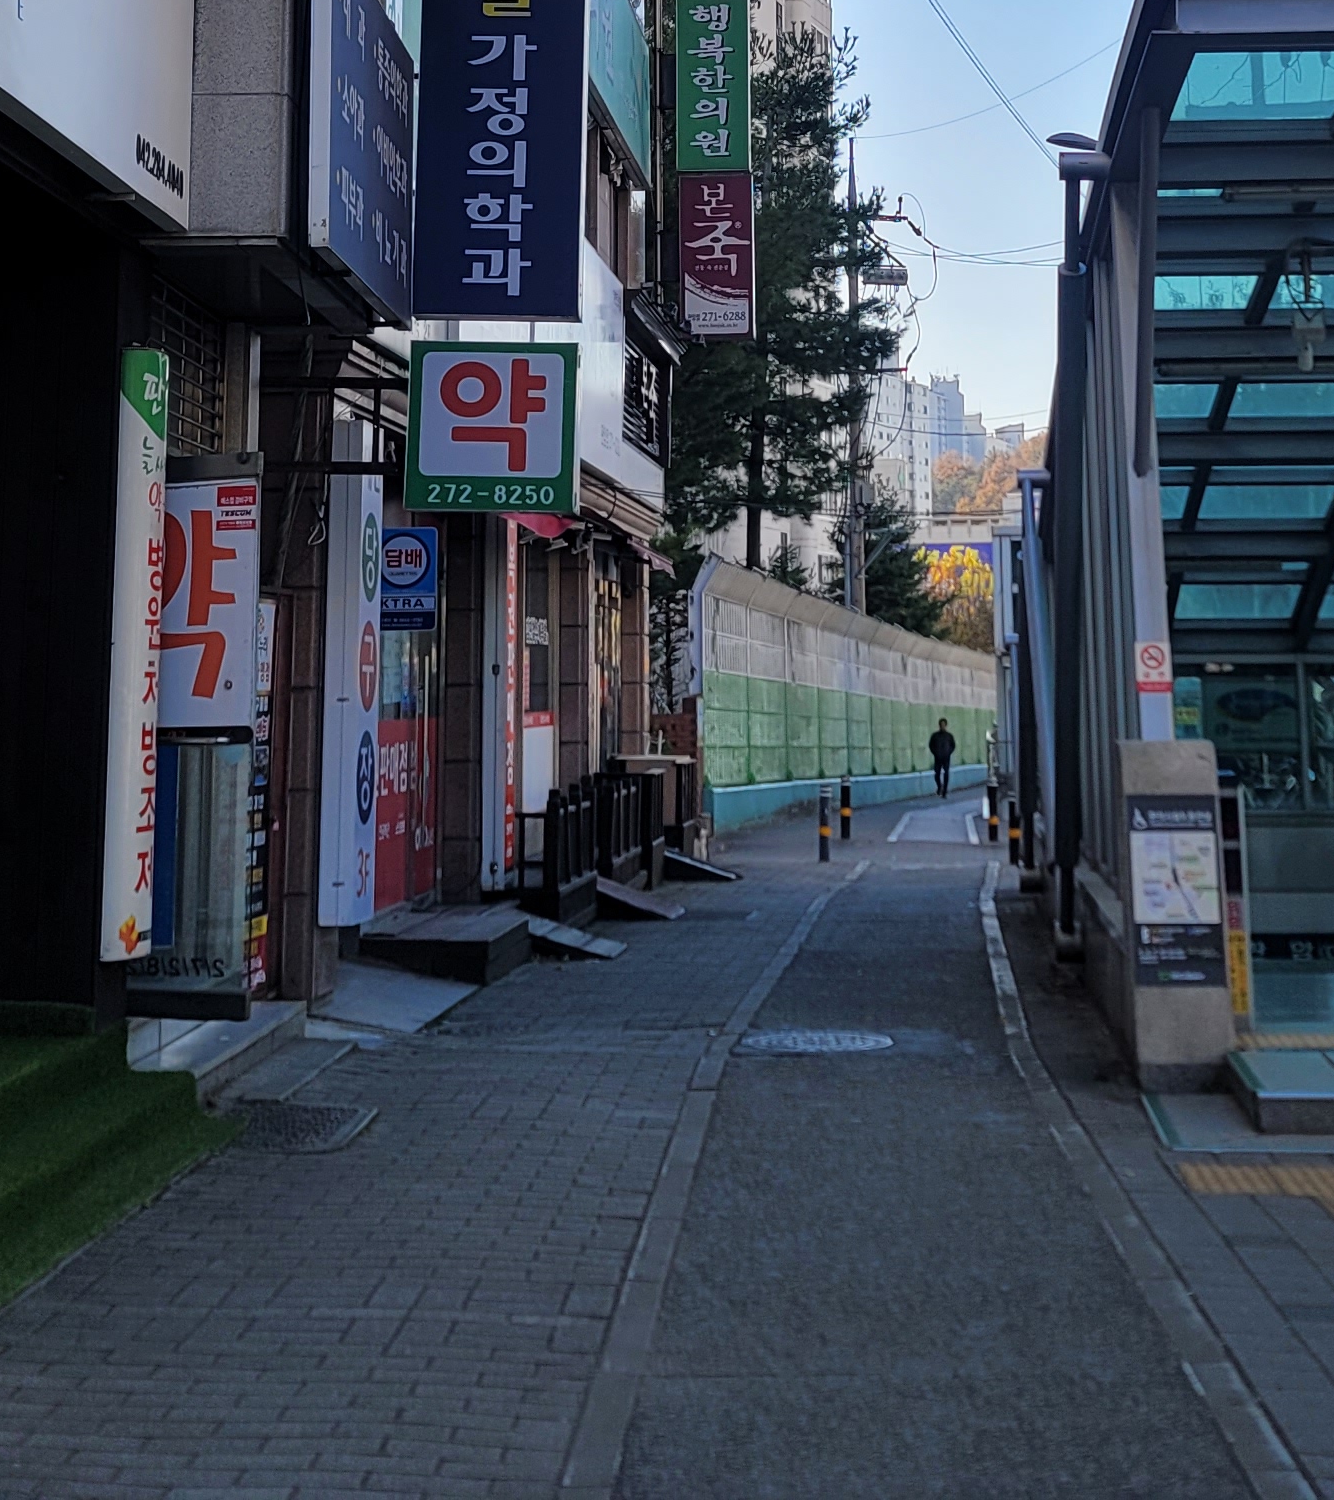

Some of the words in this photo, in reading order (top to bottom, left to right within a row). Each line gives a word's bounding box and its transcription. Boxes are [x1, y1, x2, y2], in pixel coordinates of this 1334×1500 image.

[376, 36, 409, 129] 통증의학과
[687, 4, 734, 157] 행복한의원
[341, 81, 365, 152] 소아과
[375, 126, 408, 208] 이비인후과
[339, 165, 365, 243] 피부과
[374, 207, 408, 289] 비뇨기과
[684, 183, 750, 277] 본죽
[701, 311, 746, 322] 271-6288
[439, 358, 547, 473] 약
[220, 509, 252, 518] TESCOM
[427, 483, 555, 505] 272-8250
[385, 548, 423, 569] 담배
